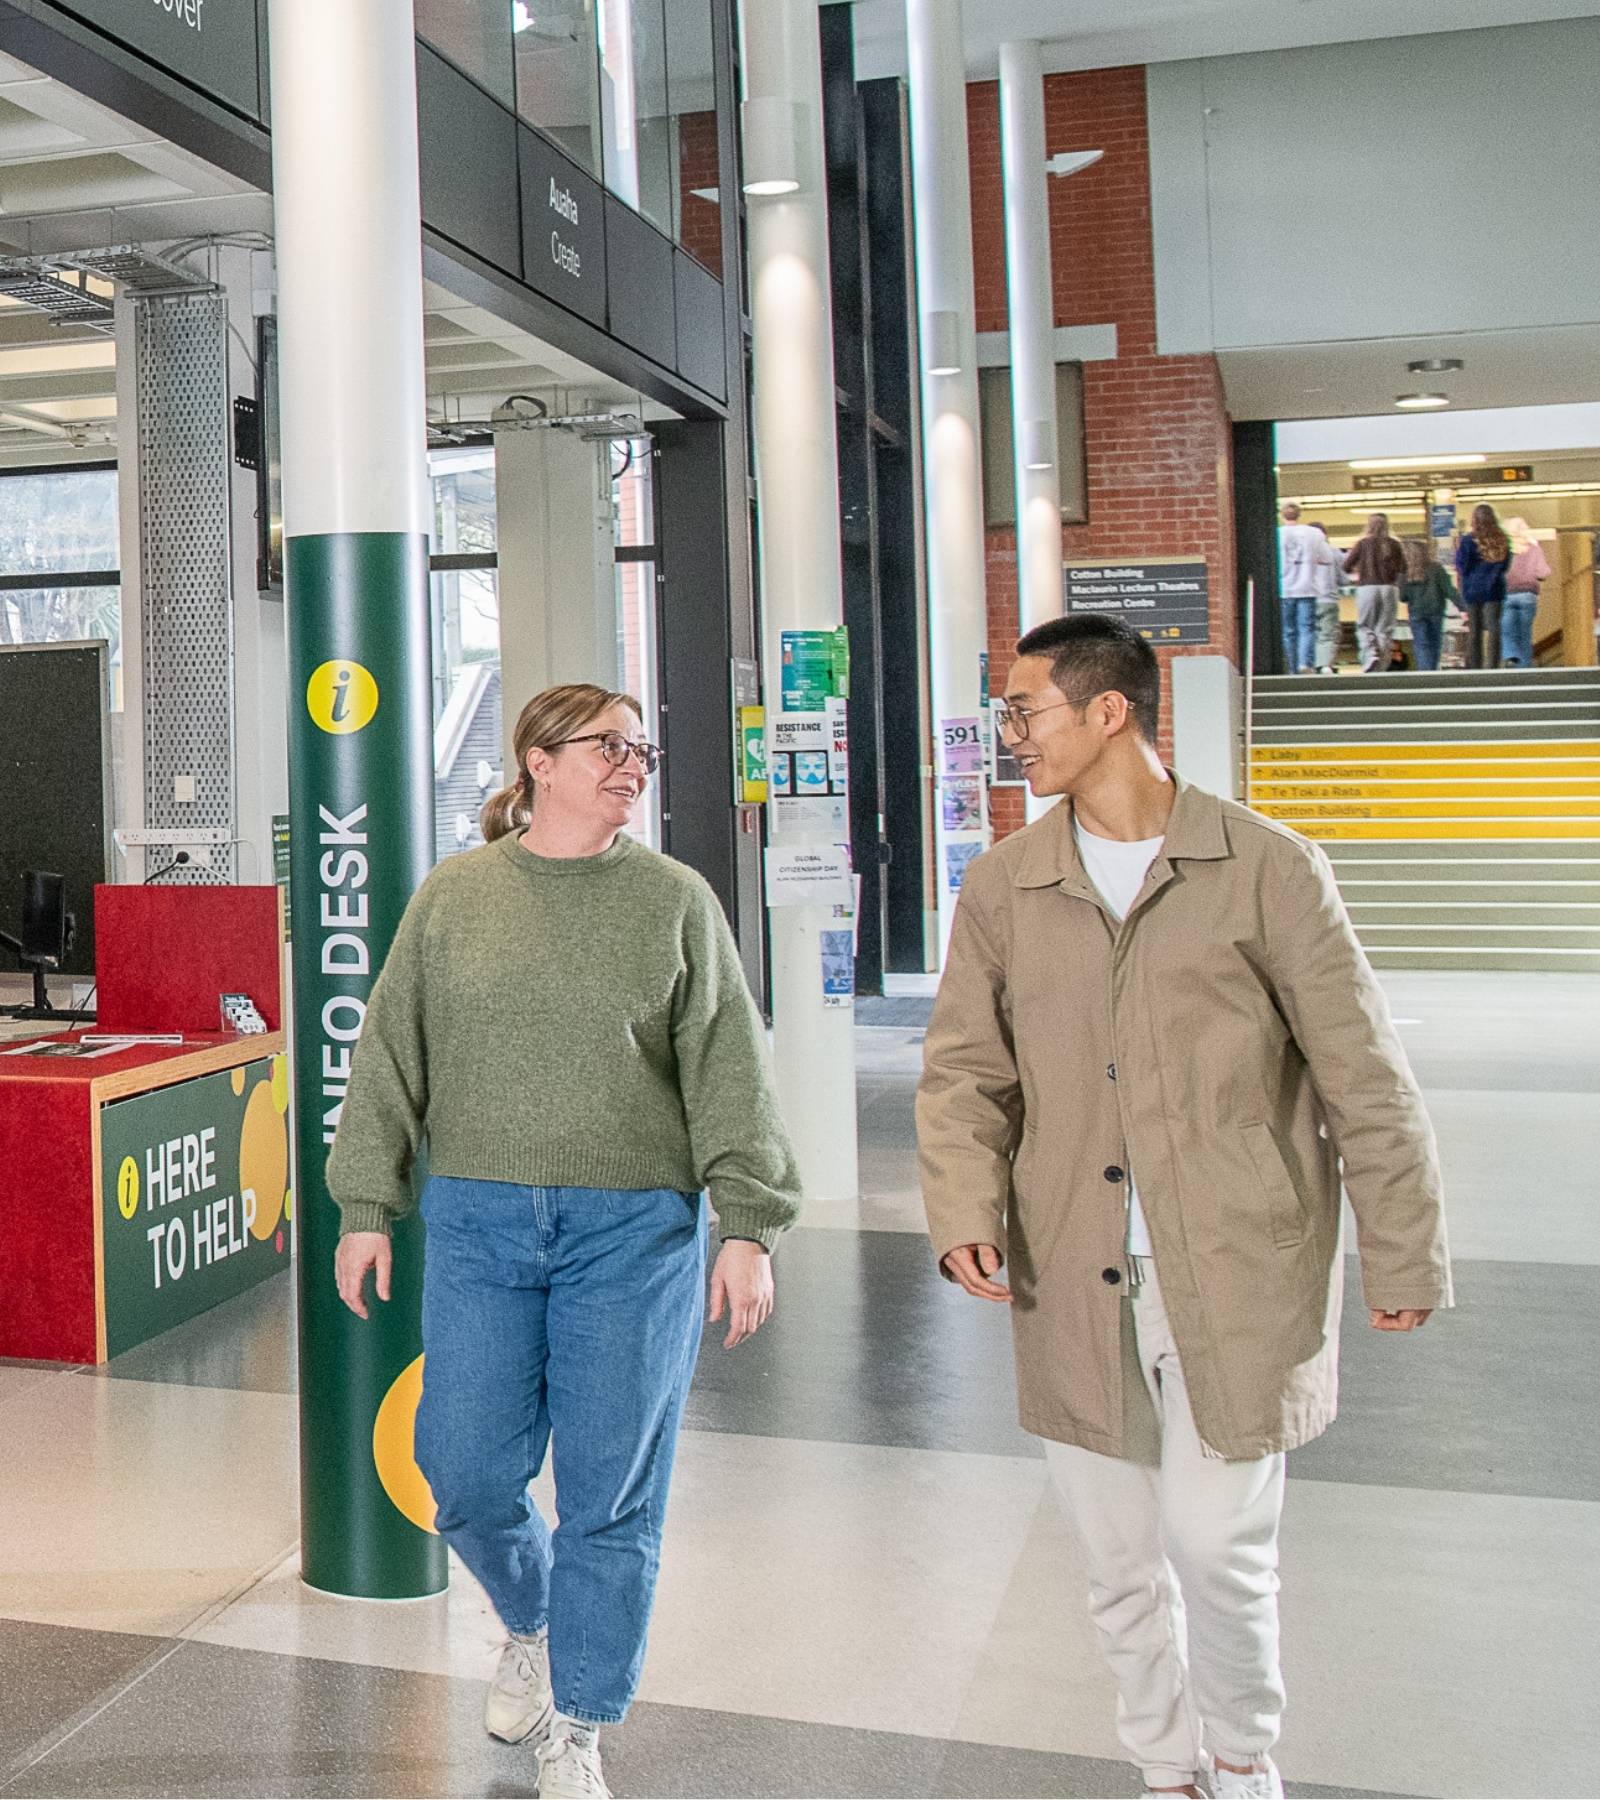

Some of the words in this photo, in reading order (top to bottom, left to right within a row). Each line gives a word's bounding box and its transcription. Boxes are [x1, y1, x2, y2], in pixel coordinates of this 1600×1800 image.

[549, 176, 578, 225] Auaha
[552, 230, 580, 277] Create
[1103, 568, 1144, 578] Building
[1120, 583, 1157, 593] Lecture
[1071, 600, 1122, 609] Recreation
[775, 722, 822, 732] RESISTANCE
[944, 724, 980, 746] 591
[1271, 768, 1299, 778] Alan
[1270, 805, 1315, 816] Cotton
[1318, 805, 1372, 818] Building
[779, 865, 823, 873] CITIZENSHIP
[319, 802, 369, 975] DESK
[146, 1126, 217, 1211] HERE
[147, 1216, 187, 1289] TO
[193, 1187, 257, 1270] HELP
